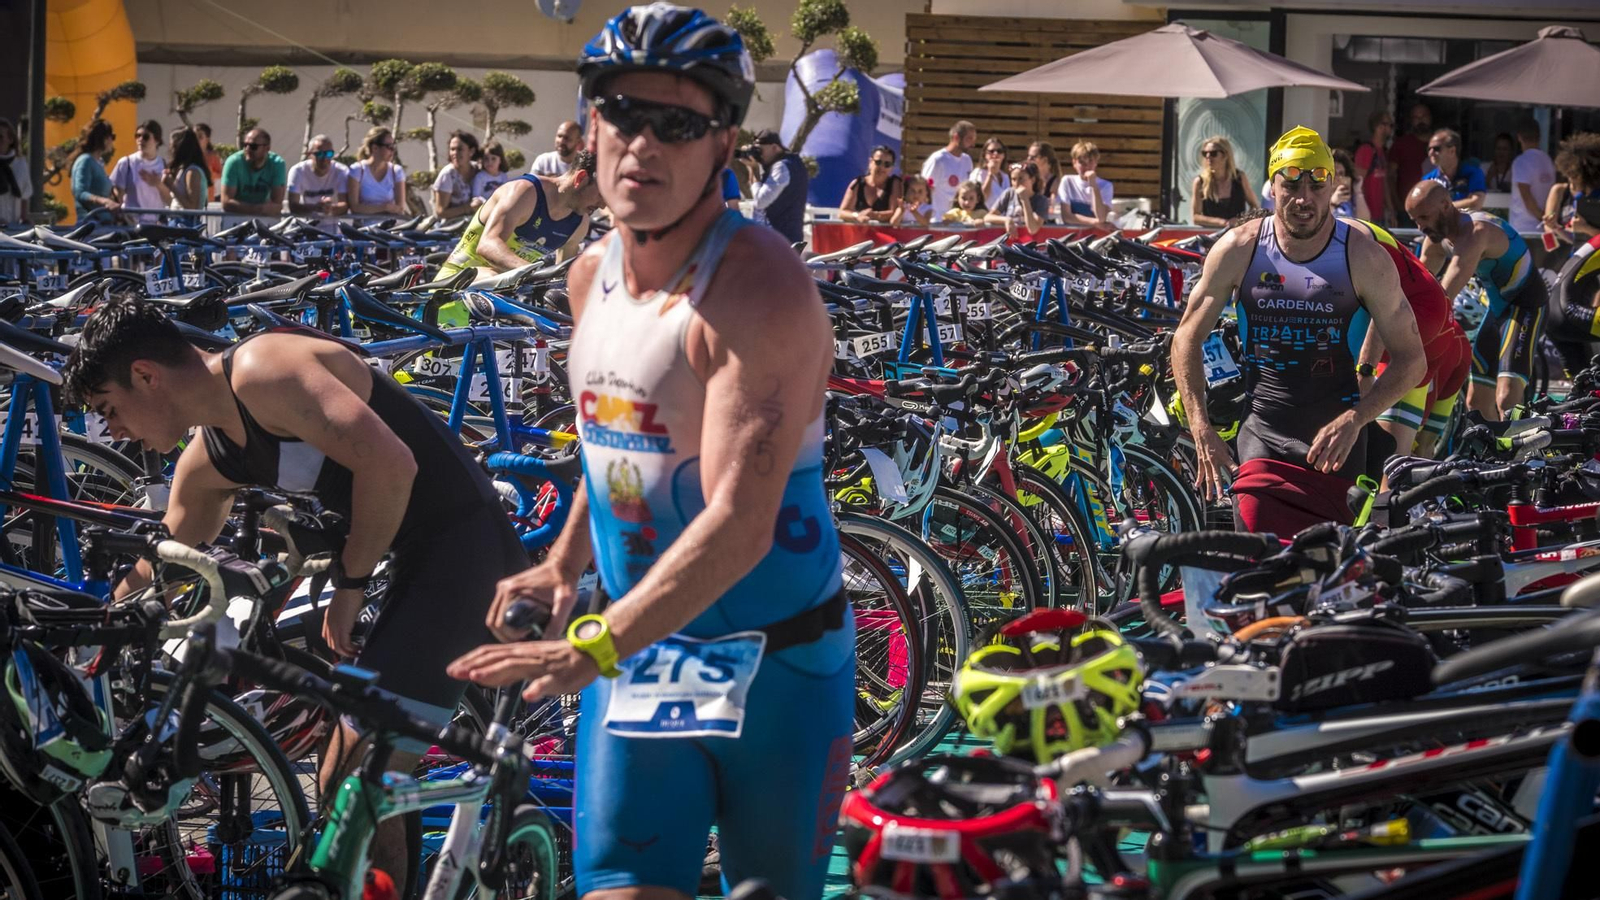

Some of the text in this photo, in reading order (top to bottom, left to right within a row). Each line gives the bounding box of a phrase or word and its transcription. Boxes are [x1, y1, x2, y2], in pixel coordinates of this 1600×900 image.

[1257, 298, 1334, 313] CARDENAS
[861, 334, 888, 354] 255
[421, 358, 452, 376] 307
[480, 382, 511, 398] 26
[629, 646, 738, 685] 275
